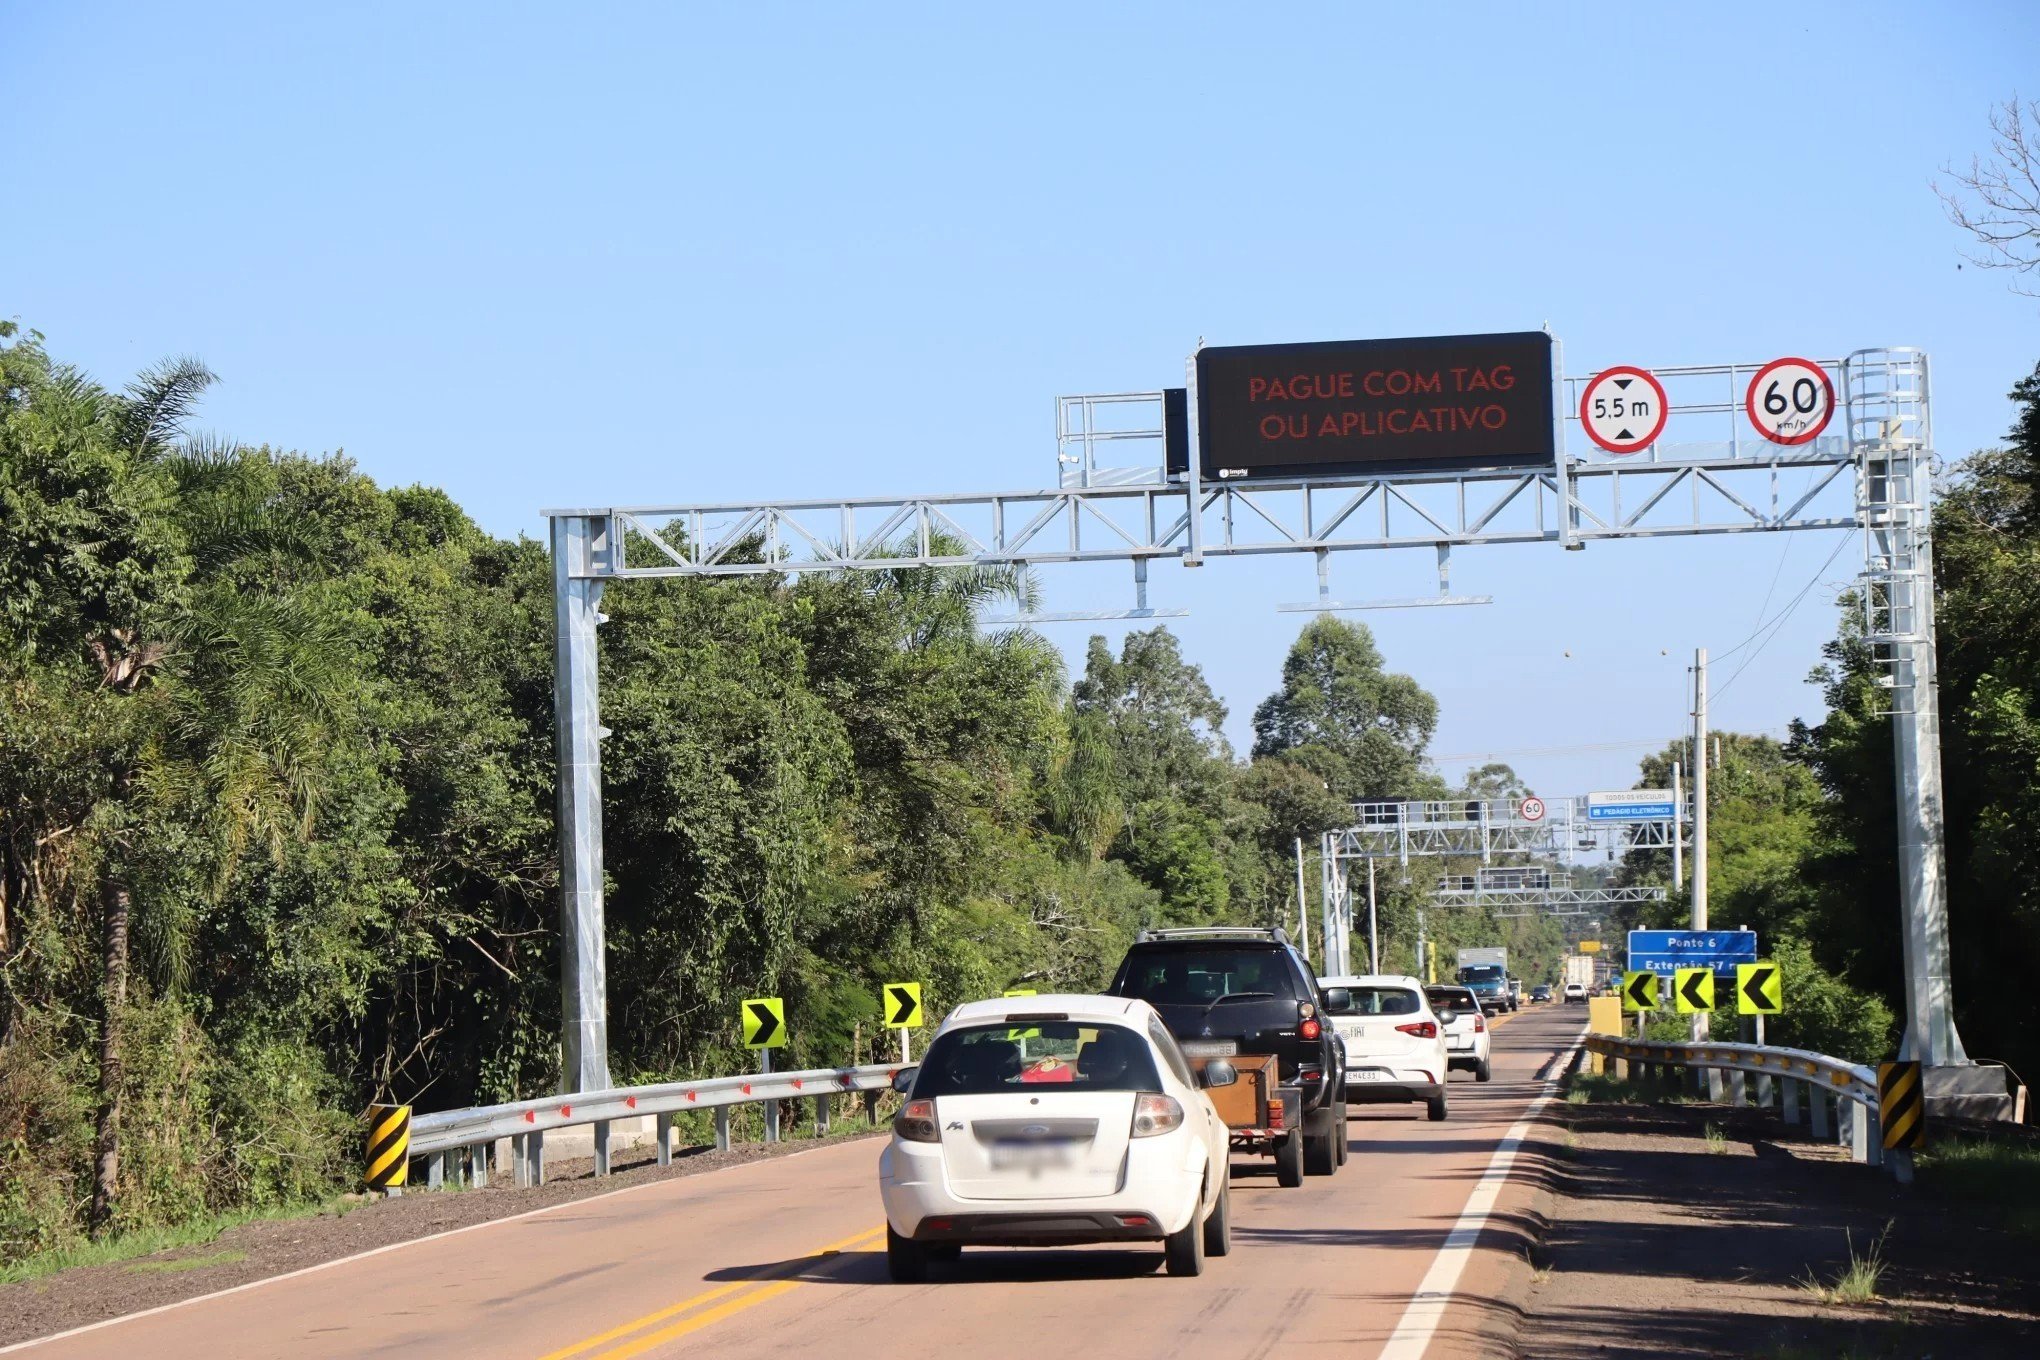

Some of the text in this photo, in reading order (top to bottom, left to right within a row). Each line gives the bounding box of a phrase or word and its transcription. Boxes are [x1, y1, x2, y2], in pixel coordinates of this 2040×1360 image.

[1249, 365, 1516, 402] PAGUE COM TAG
[1763, 378, 1817, 415] 60
[1595, 398, 1649, 419] 5,5 m
[1259, 404, 1507, 440] OU APLICATIVO
[1776, 420, 1807, 429] km/h
[1525, 803, 1540, 813] 60
[1668, 938, 1716, 947] Ponte 6
[1350, 1027, 1365, 1037] FIAT
